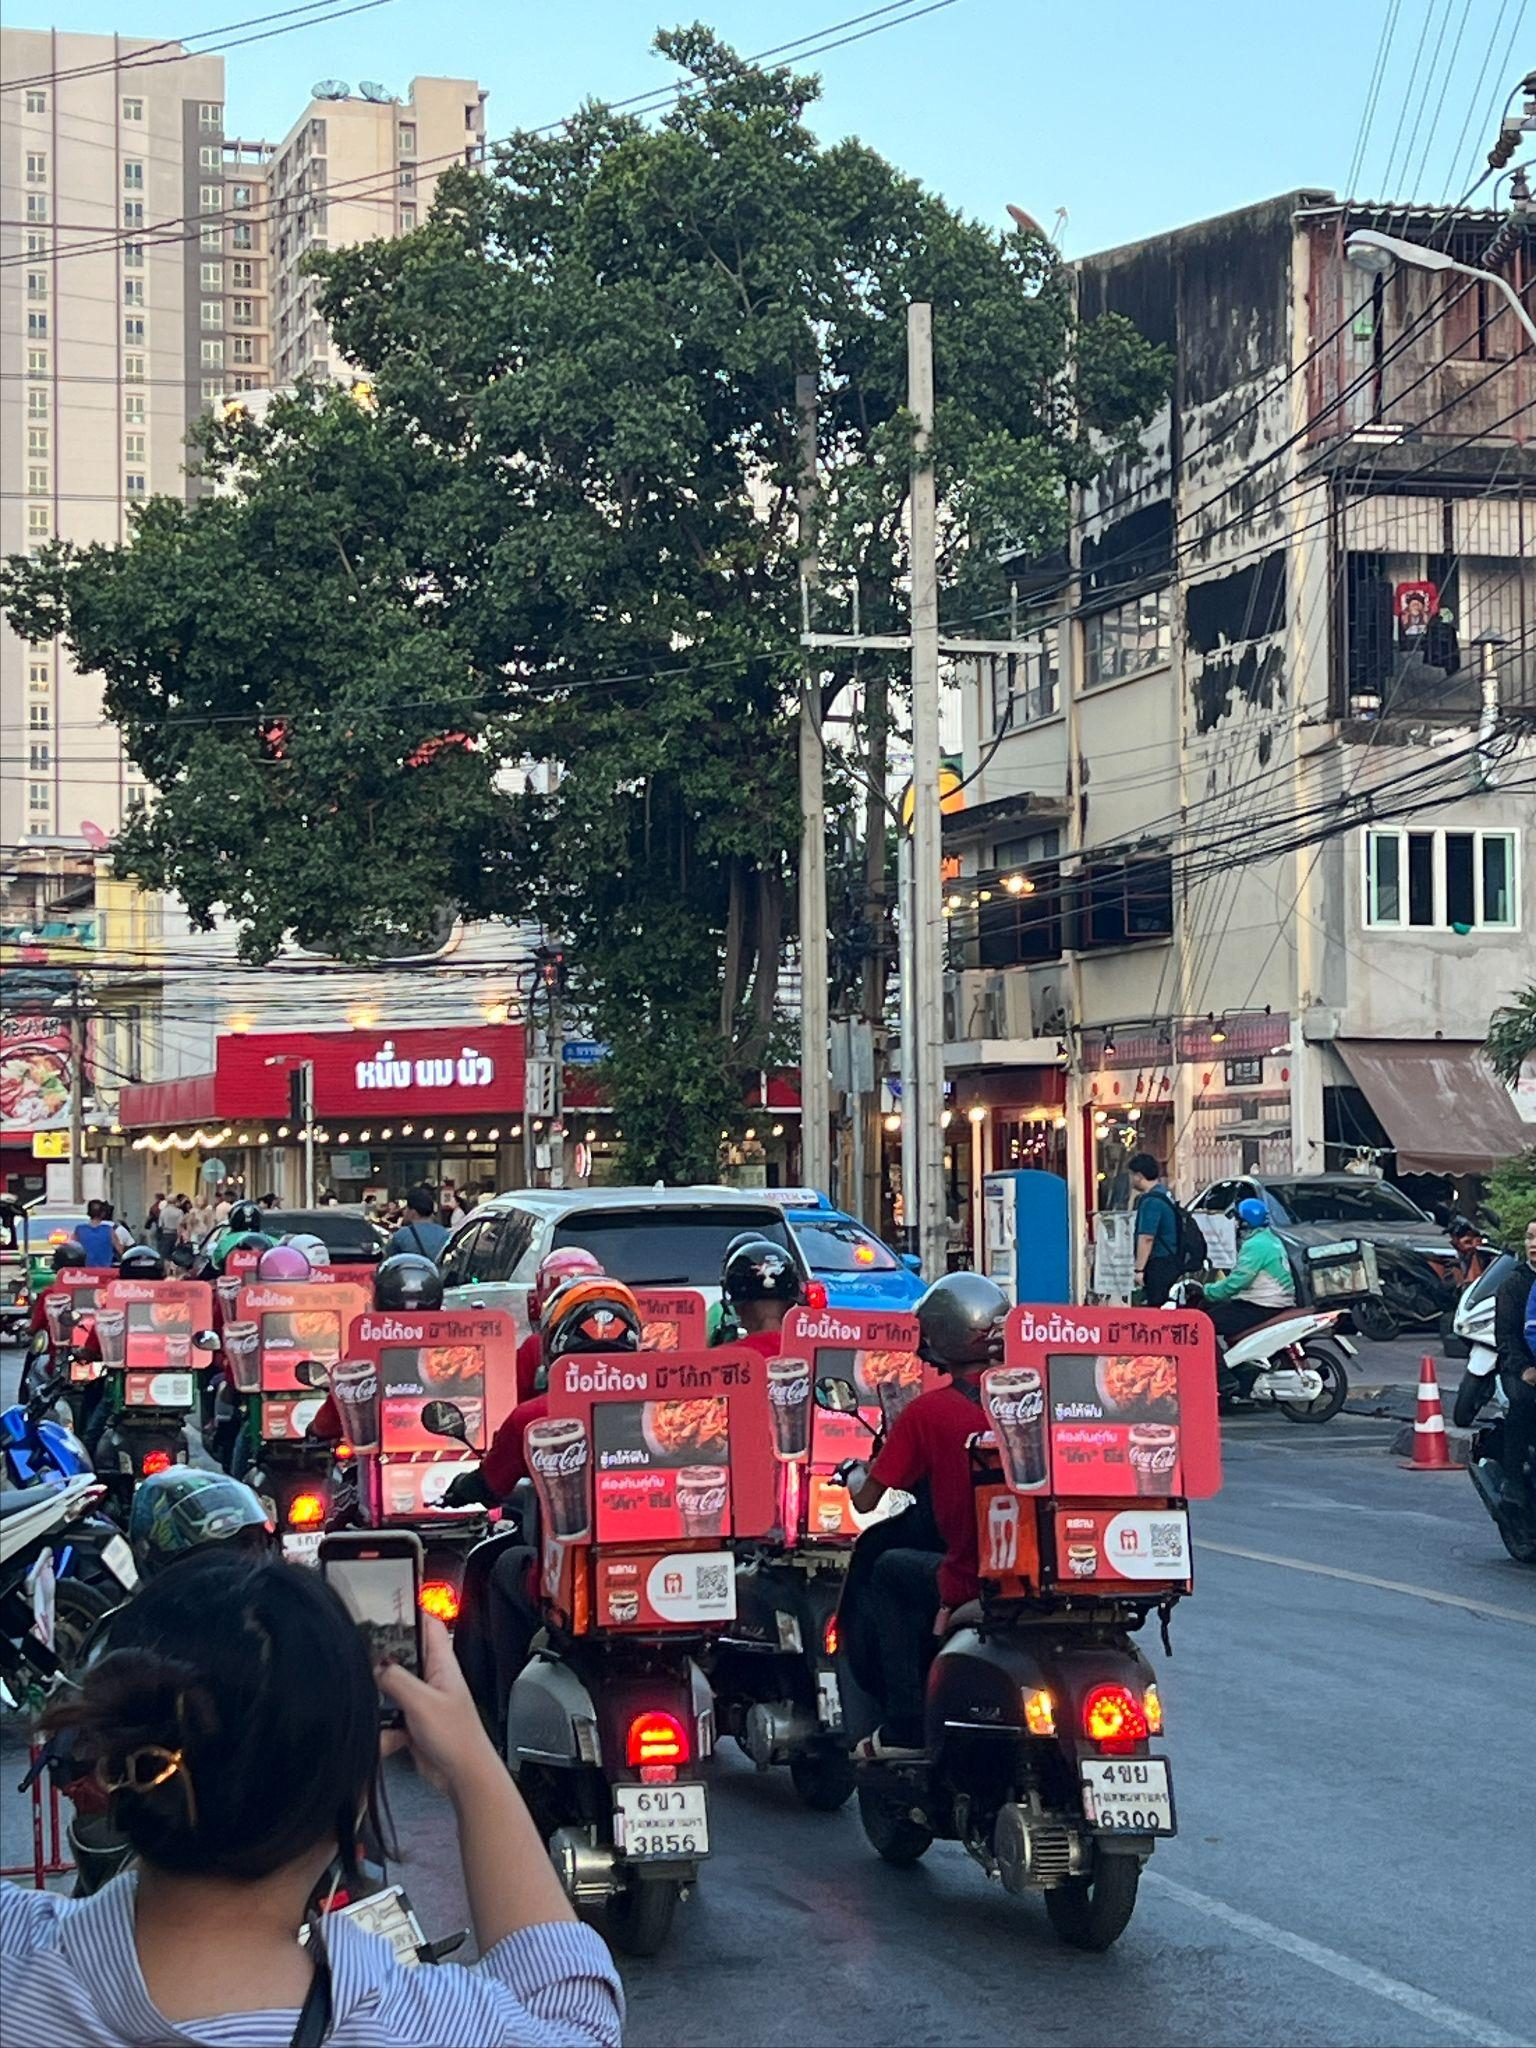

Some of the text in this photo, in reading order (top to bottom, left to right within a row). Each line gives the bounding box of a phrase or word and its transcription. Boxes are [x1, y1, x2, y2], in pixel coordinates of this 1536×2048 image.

[415, 1058, 455, 1087] นม
[796, 1311, 861, 1341] มื้อนี้ต้อง
[1021, 1310, 1100, 1344] มื้อนี้ต้อง
[565, 1361, 648, 1392] มื้อนี้ต้อง
[990, 1390, 1043, 1419] Coca-Cola
[532, 1440, 587, 1471] Coca-Cola
[1101, 1810, 1160, 1829] 6300
[634, 1834, 696, 1854] 3856
